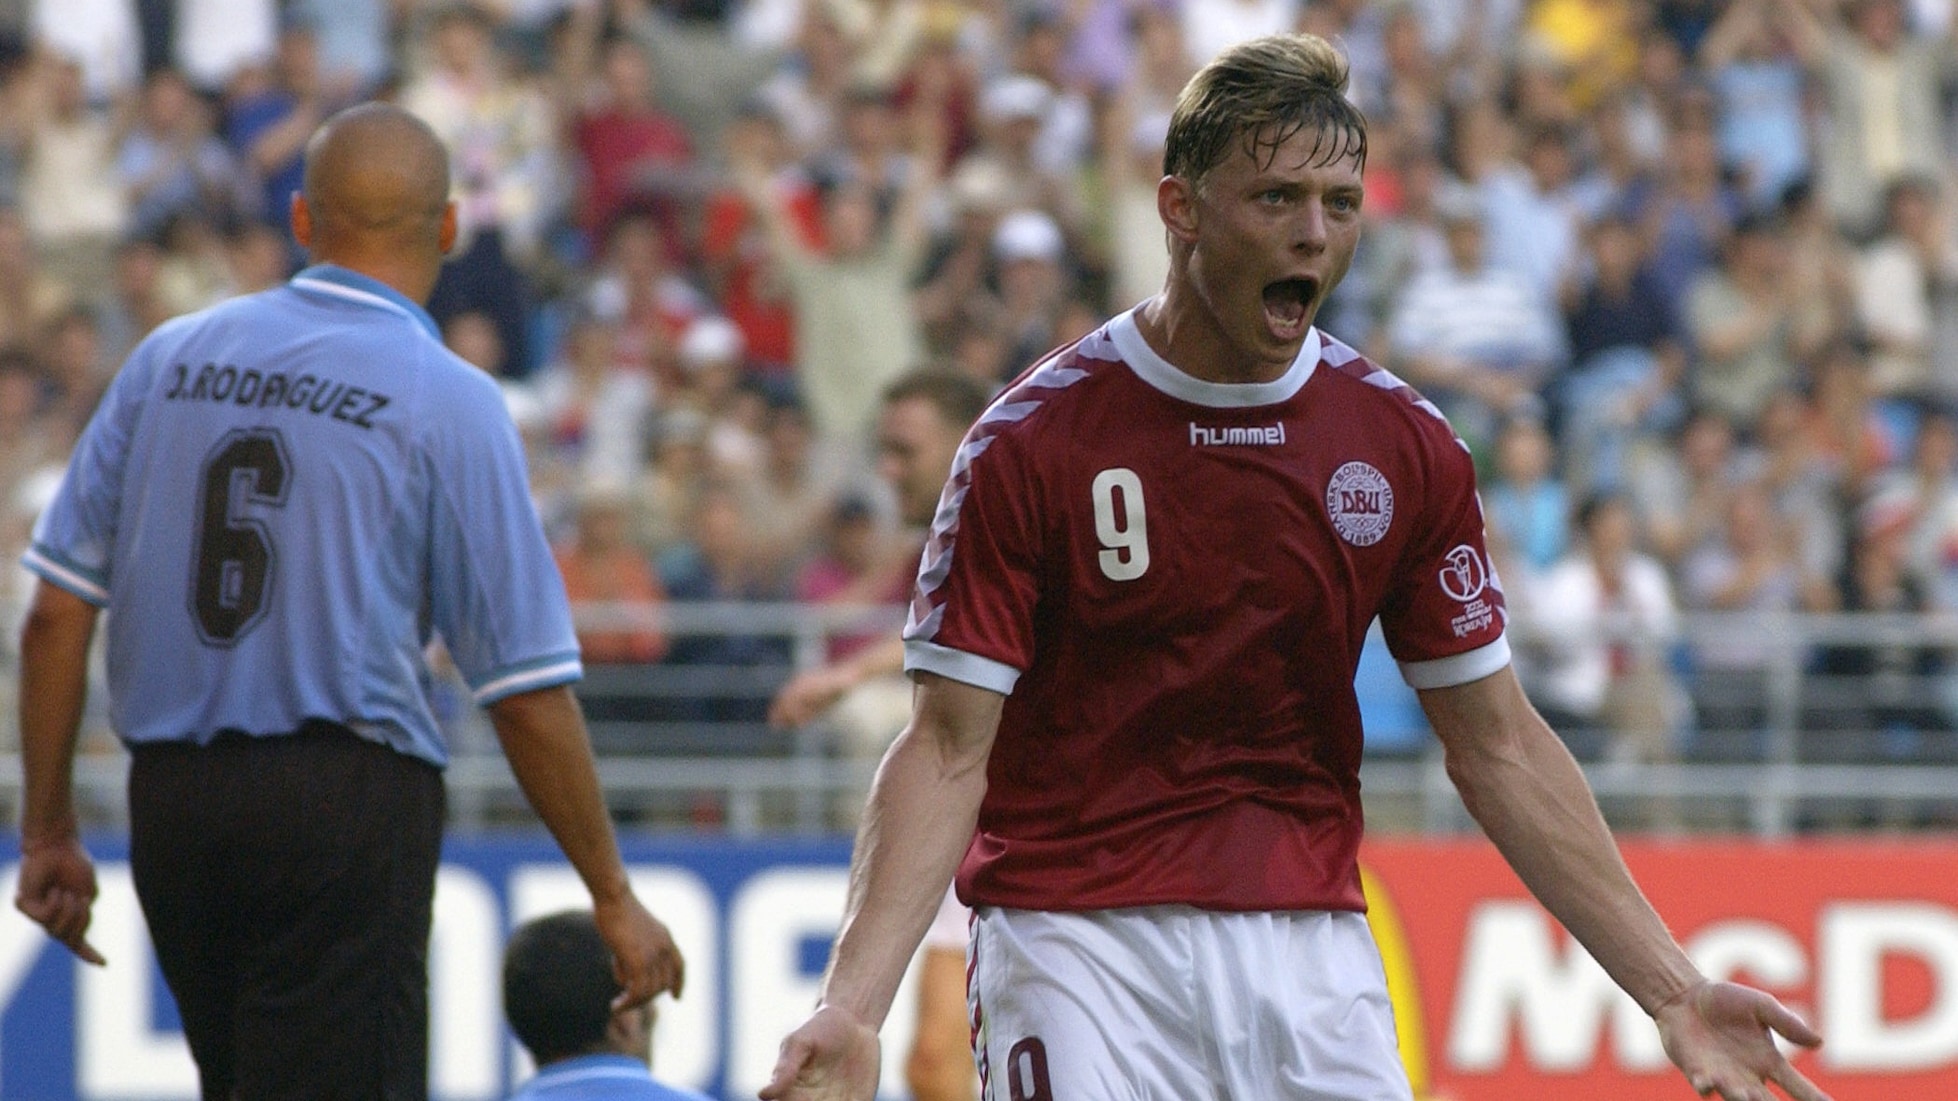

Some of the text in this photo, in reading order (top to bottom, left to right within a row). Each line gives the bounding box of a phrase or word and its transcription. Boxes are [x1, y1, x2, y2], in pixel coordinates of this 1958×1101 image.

[1189, 421, 1286, 446] hummel
[1092, 467, 1150, 581] 9
[1341, 489, 1381, 514] DBU
[188, 426, 294, 649] 6
